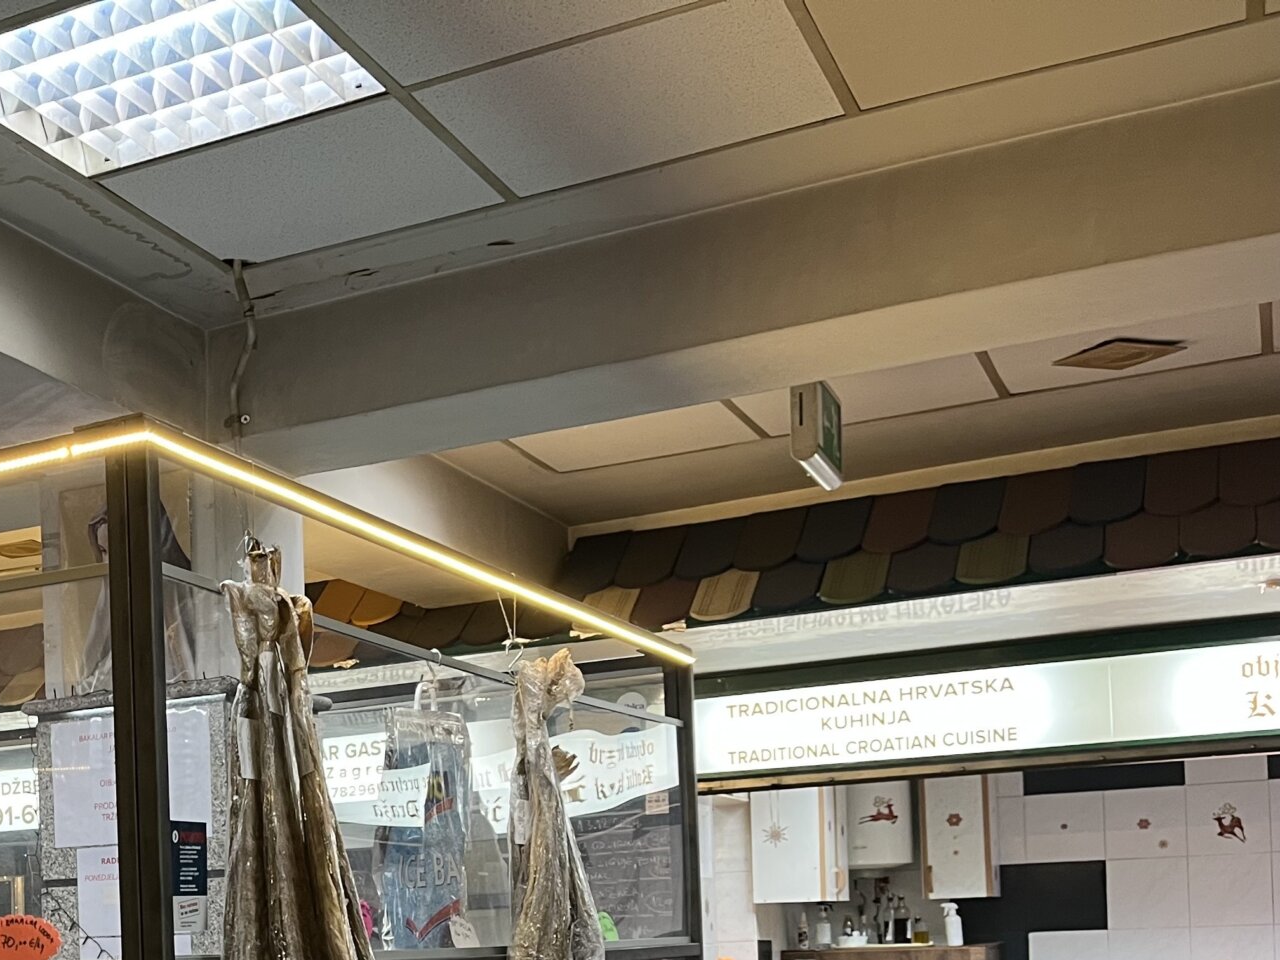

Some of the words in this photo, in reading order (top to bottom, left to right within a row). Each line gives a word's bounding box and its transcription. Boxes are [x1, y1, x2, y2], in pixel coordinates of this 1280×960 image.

[726, 689, 892, 718] TRADICIONALNA
[899, 677, 1015, 702] HRVATSKA
[820, 710, 912, 731] KUHINJA
[728, 742, 840, 765] TRADITIONAL
[846, 734, 937, 756] CROATIAN
[943, 727, 1018, 747] CUISINE
